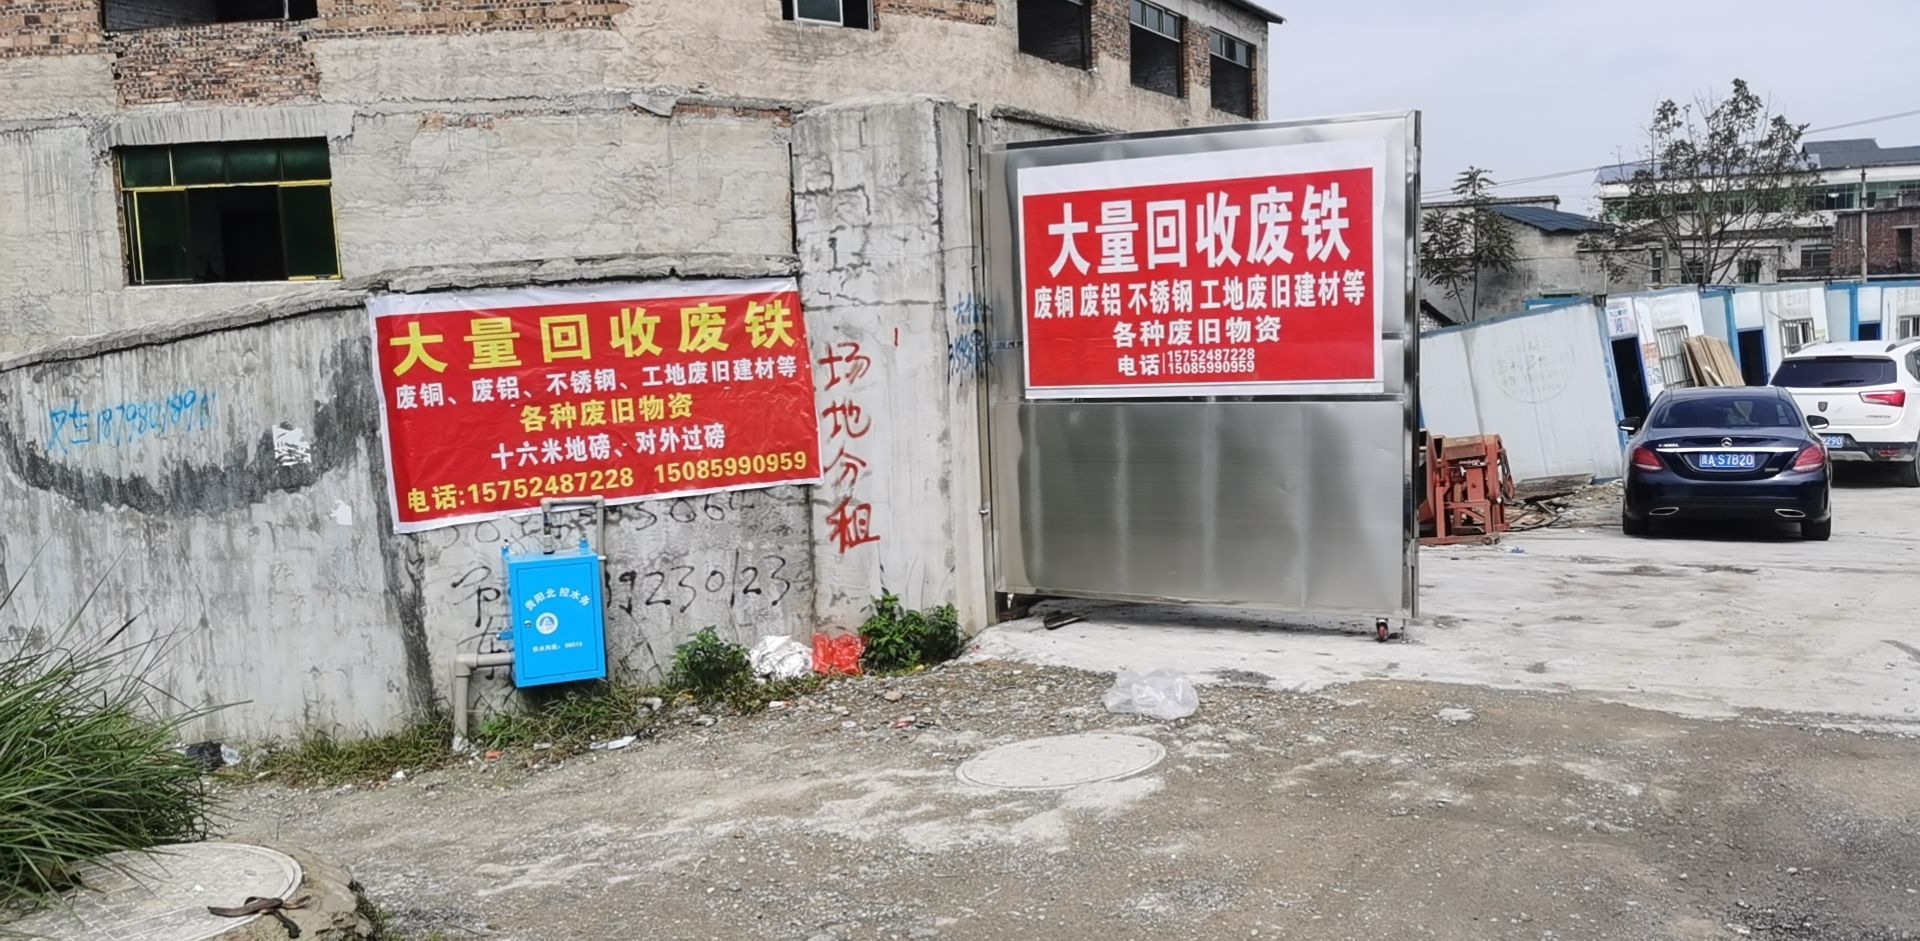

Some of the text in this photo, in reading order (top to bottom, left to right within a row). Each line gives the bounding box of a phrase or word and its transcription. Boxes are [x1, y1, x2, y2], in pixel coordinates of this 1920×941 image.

[1047, 181, 1351, 279] 大量回收废铁
[1033, 285, 1074, 320] 废铜
[1080, 281, 1122, 318] 废铝
[1128, 278, 1193, 316] 不锈钢
[1200, 268, 1366, 312] 工地废旧建材等
[389, 298, 797, 377] 大量回收废铁
[1112, 314, 1282, 349] 各种废旧物资
[1117, 347, 1256, 377] 电话 15752487228
[1167, 360, 1256, 375] 15085990959
[519, 391, 695, 434] 各种废旧物资
[490, 422, 727, 471] 十六米地磅、对外过磅
[654, 450, 808, 485] 15085990959
[817, 341, 881, 555] 场地分租
